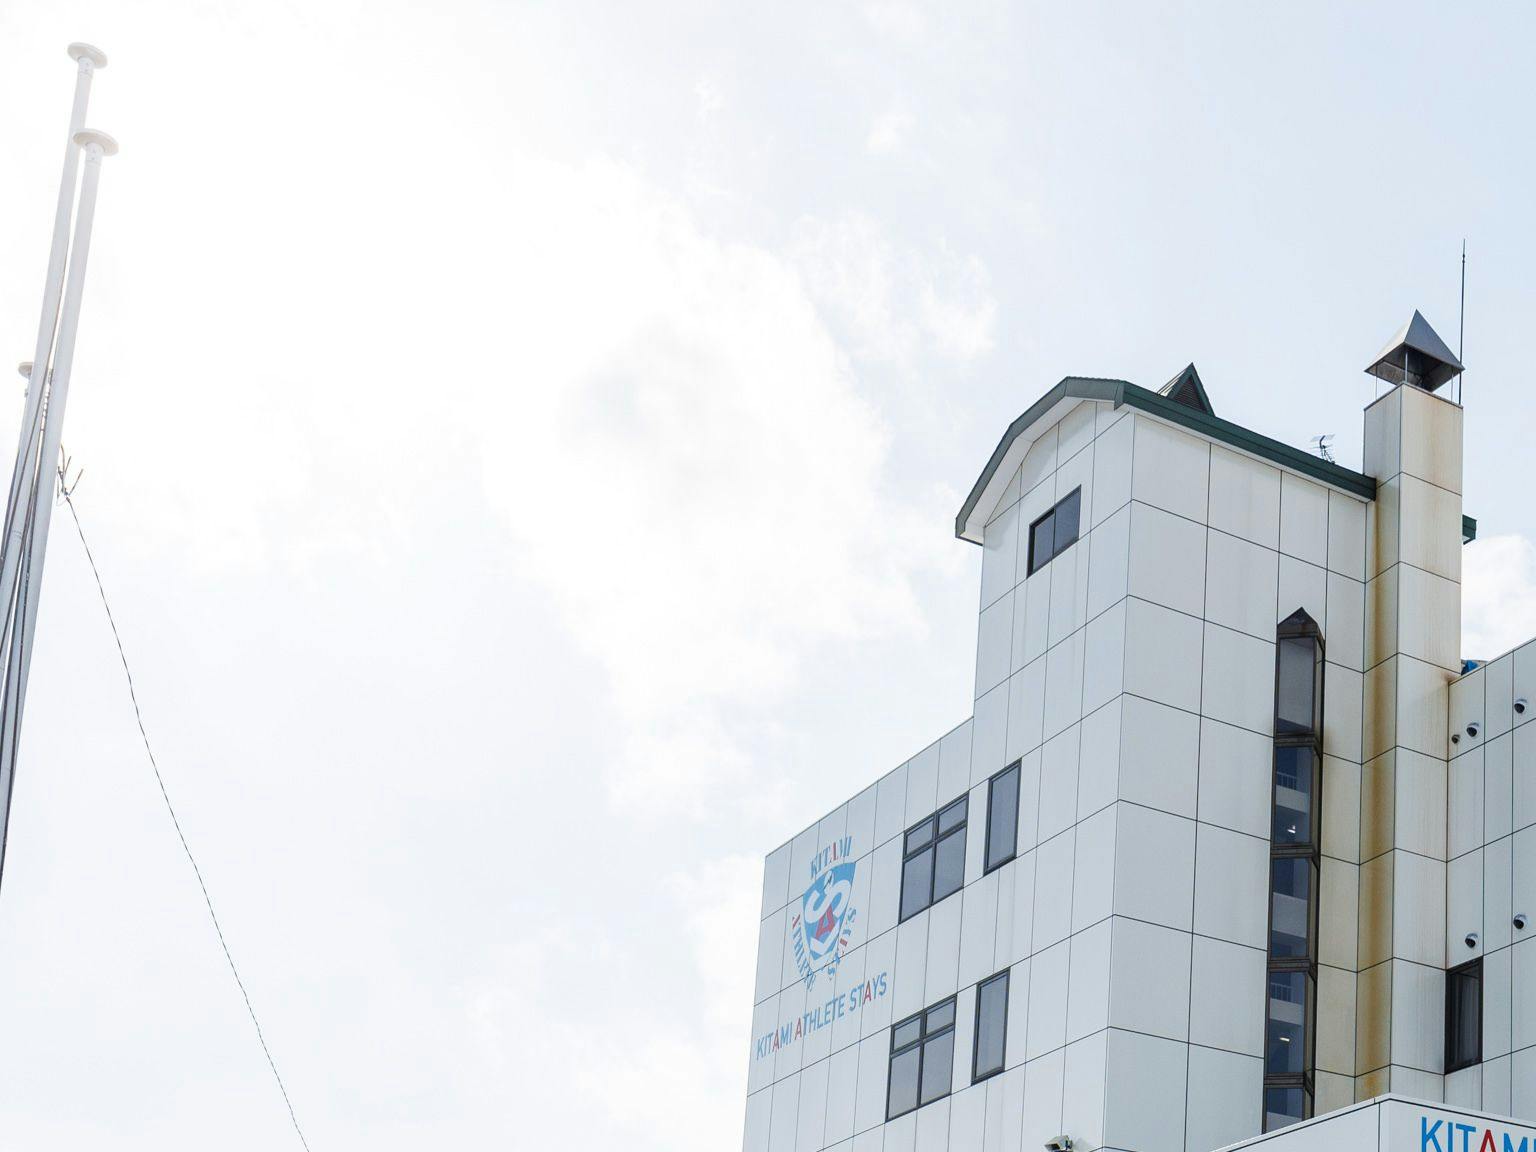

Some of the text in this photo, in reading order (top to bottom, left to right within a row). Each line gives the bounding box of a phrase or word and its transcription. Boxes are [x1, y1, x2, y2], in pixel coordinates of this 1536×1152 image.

[756, 972, 888, 1060] KITAMI ATHLETE STAYS
